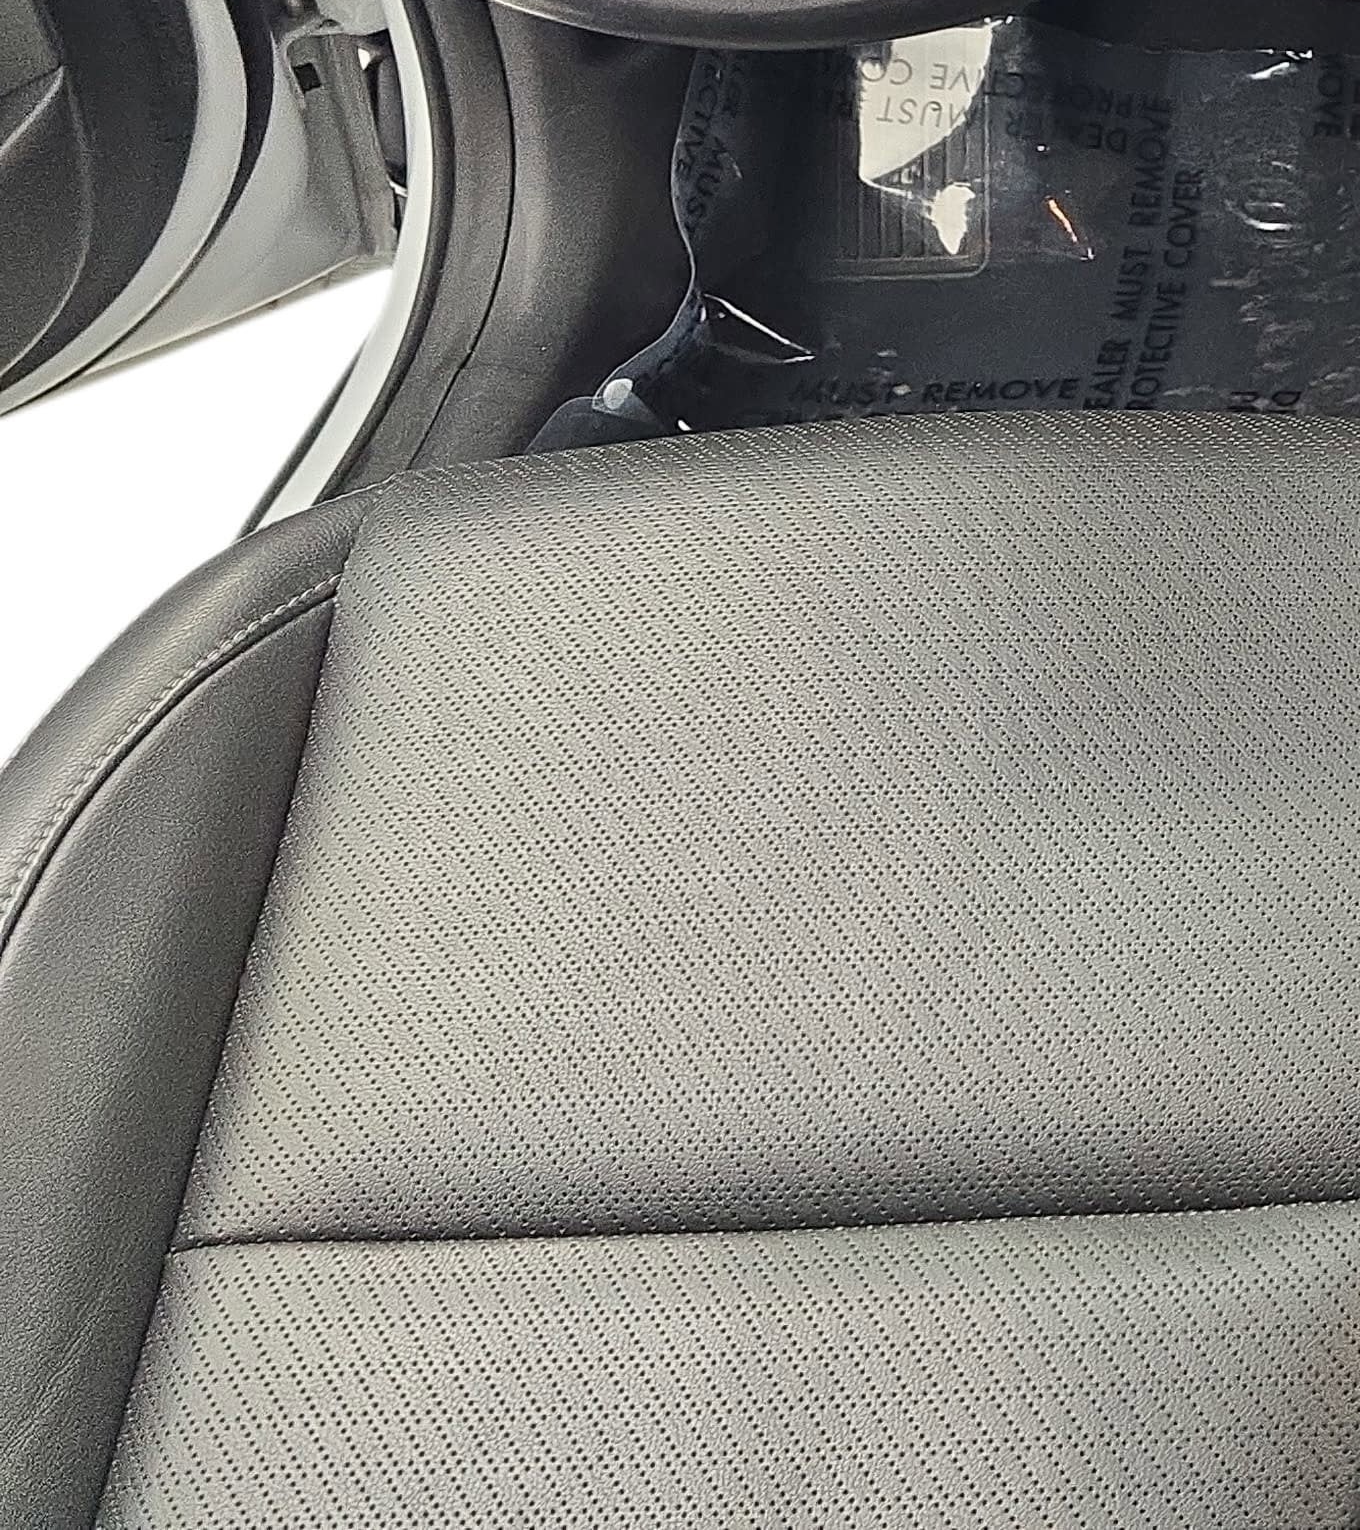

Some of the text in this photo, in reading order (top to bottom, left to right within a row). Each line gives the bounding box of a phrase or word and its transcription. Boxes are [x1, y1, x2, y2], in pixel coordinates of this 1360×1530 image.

[1083, 96, 1171, 410] EALER MUST REMOVE
[1123, 169, 1203, 410] ROTECTIVE COVER
[921, 376, 1080, 404] REMOVE
